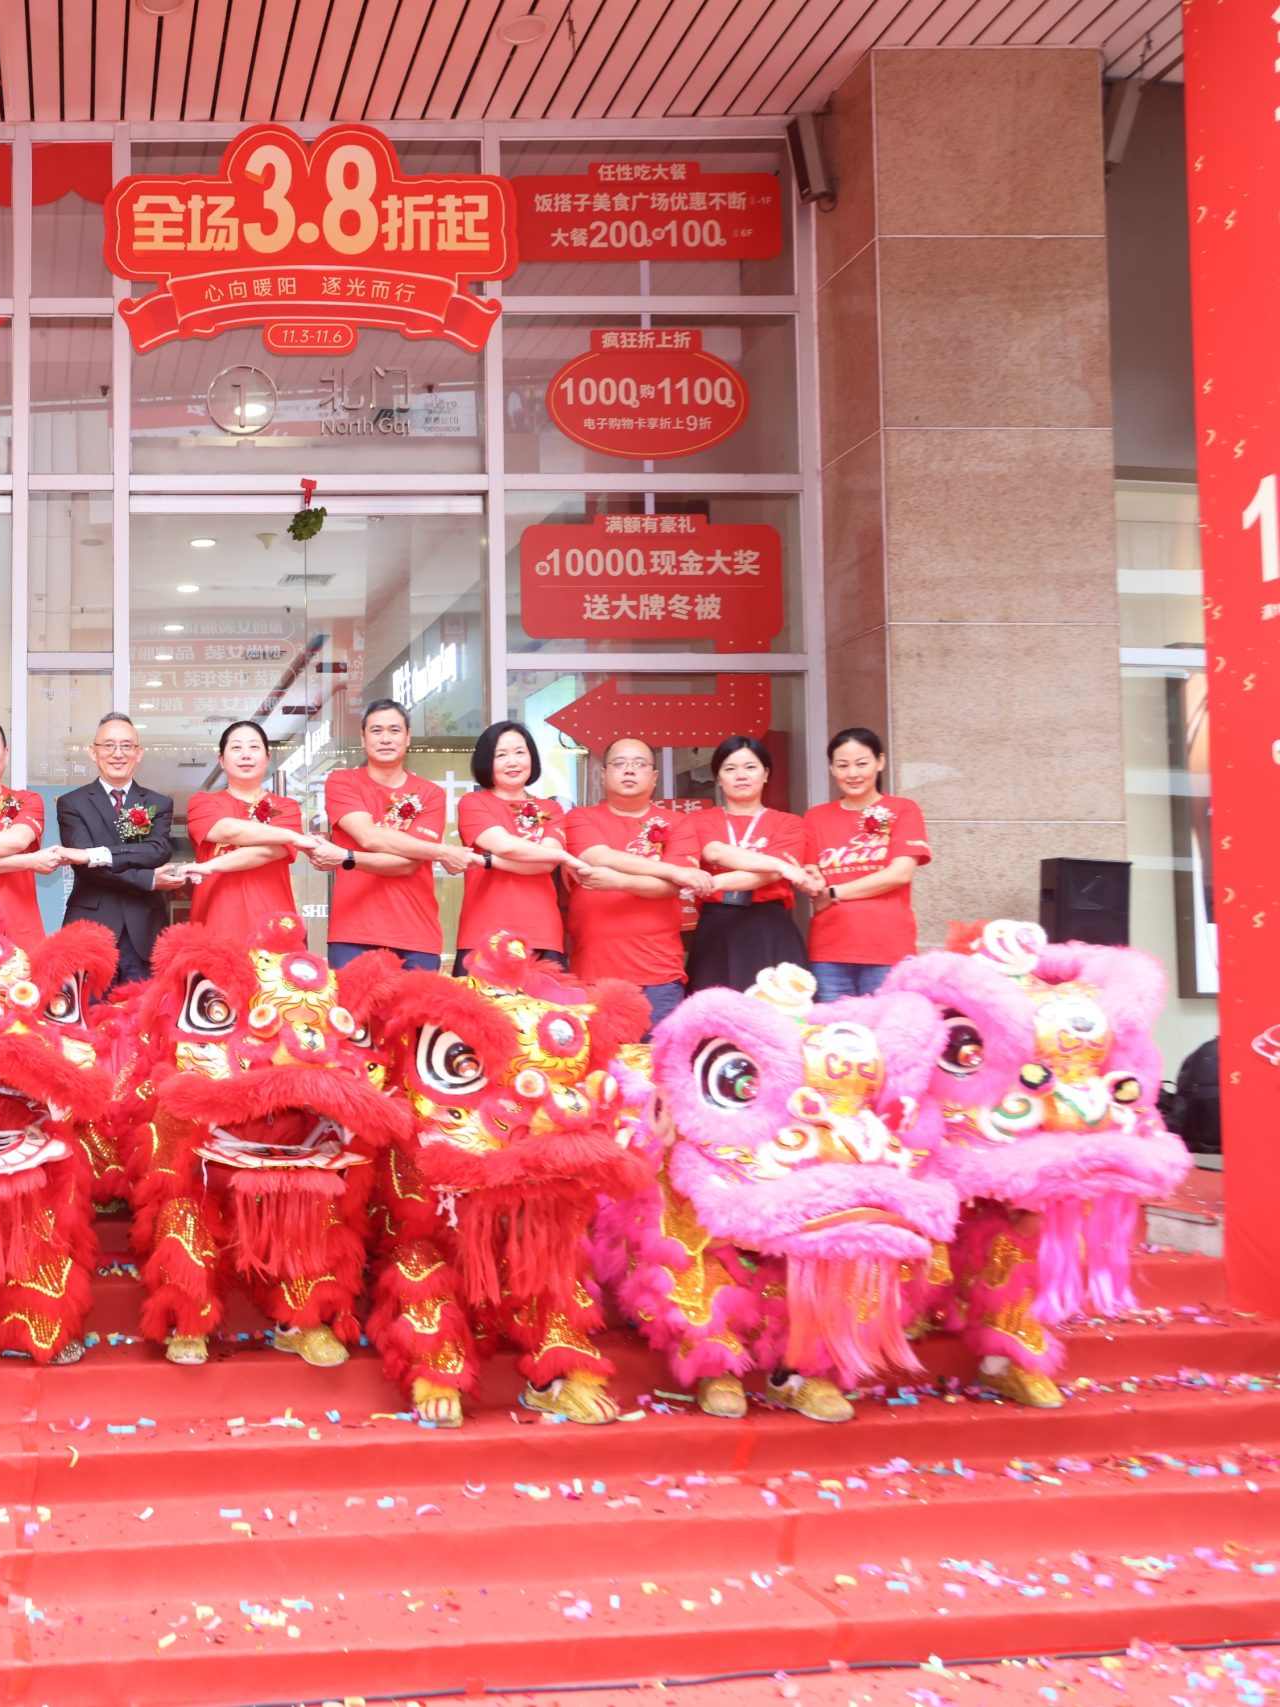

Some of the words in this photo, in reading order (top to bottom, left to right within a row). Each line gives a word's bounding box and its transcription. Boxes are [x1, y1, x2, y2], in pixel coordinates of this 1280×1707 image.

[598, 164, 688, 182] 任性吃大餐
[133, 144, 491, 255] 全场3.8折起
[534, 192, 747, 213] 饭搭子美食广场优惠不断
[205, 276, 297, 303] 心向暖阳
[321, 276, 417, 303] 逐光而行
[281, 329, 344, 345] 11.3-11.6
[602, 331, 691, 349] 疯狂折上折
[321, 417, 374, 435] North
[583, 415, 713, 432] 电子购物卡享折上9折
[605, 516, 696, 533] 满额有豪礼
[582, 593, 722, 621] 送大牌冬被
